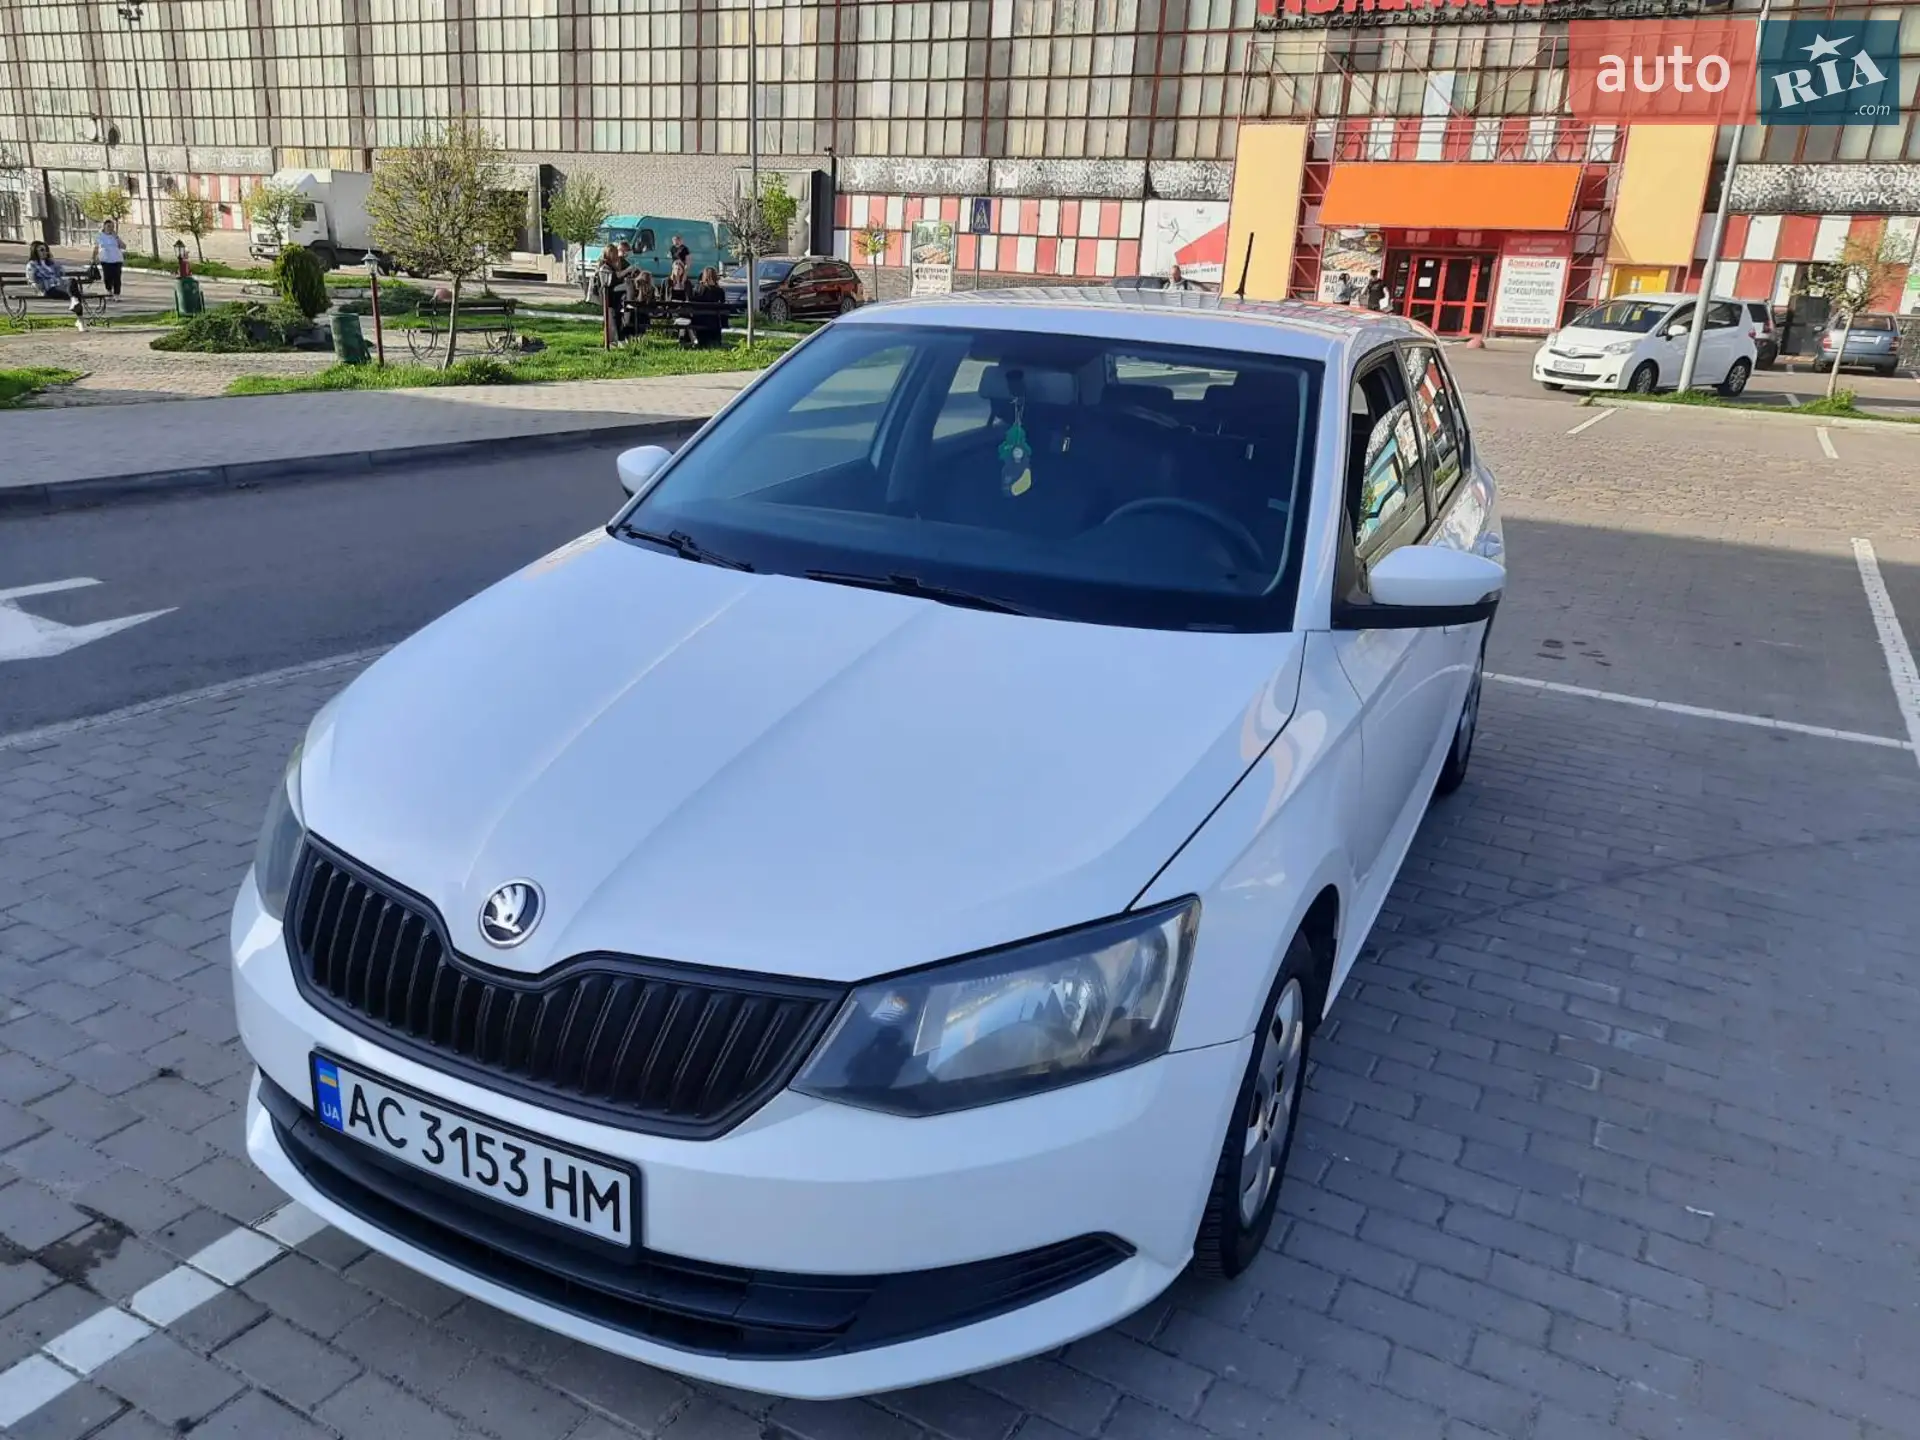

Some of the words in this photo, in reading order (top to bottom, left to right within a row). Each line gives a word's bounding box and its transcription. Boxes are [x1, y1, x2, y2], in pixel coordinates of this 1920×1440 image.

[894, 166, 967, 185] БАТУТИ
[1838, 191, 1893, 205] ПАРК
[321, 1102, 341, 1121] UA
[349, 1084, 407, 1149] AC
[419, 1110, 529, 1198] 3153
[543, 1157, 621, 1233] HM
